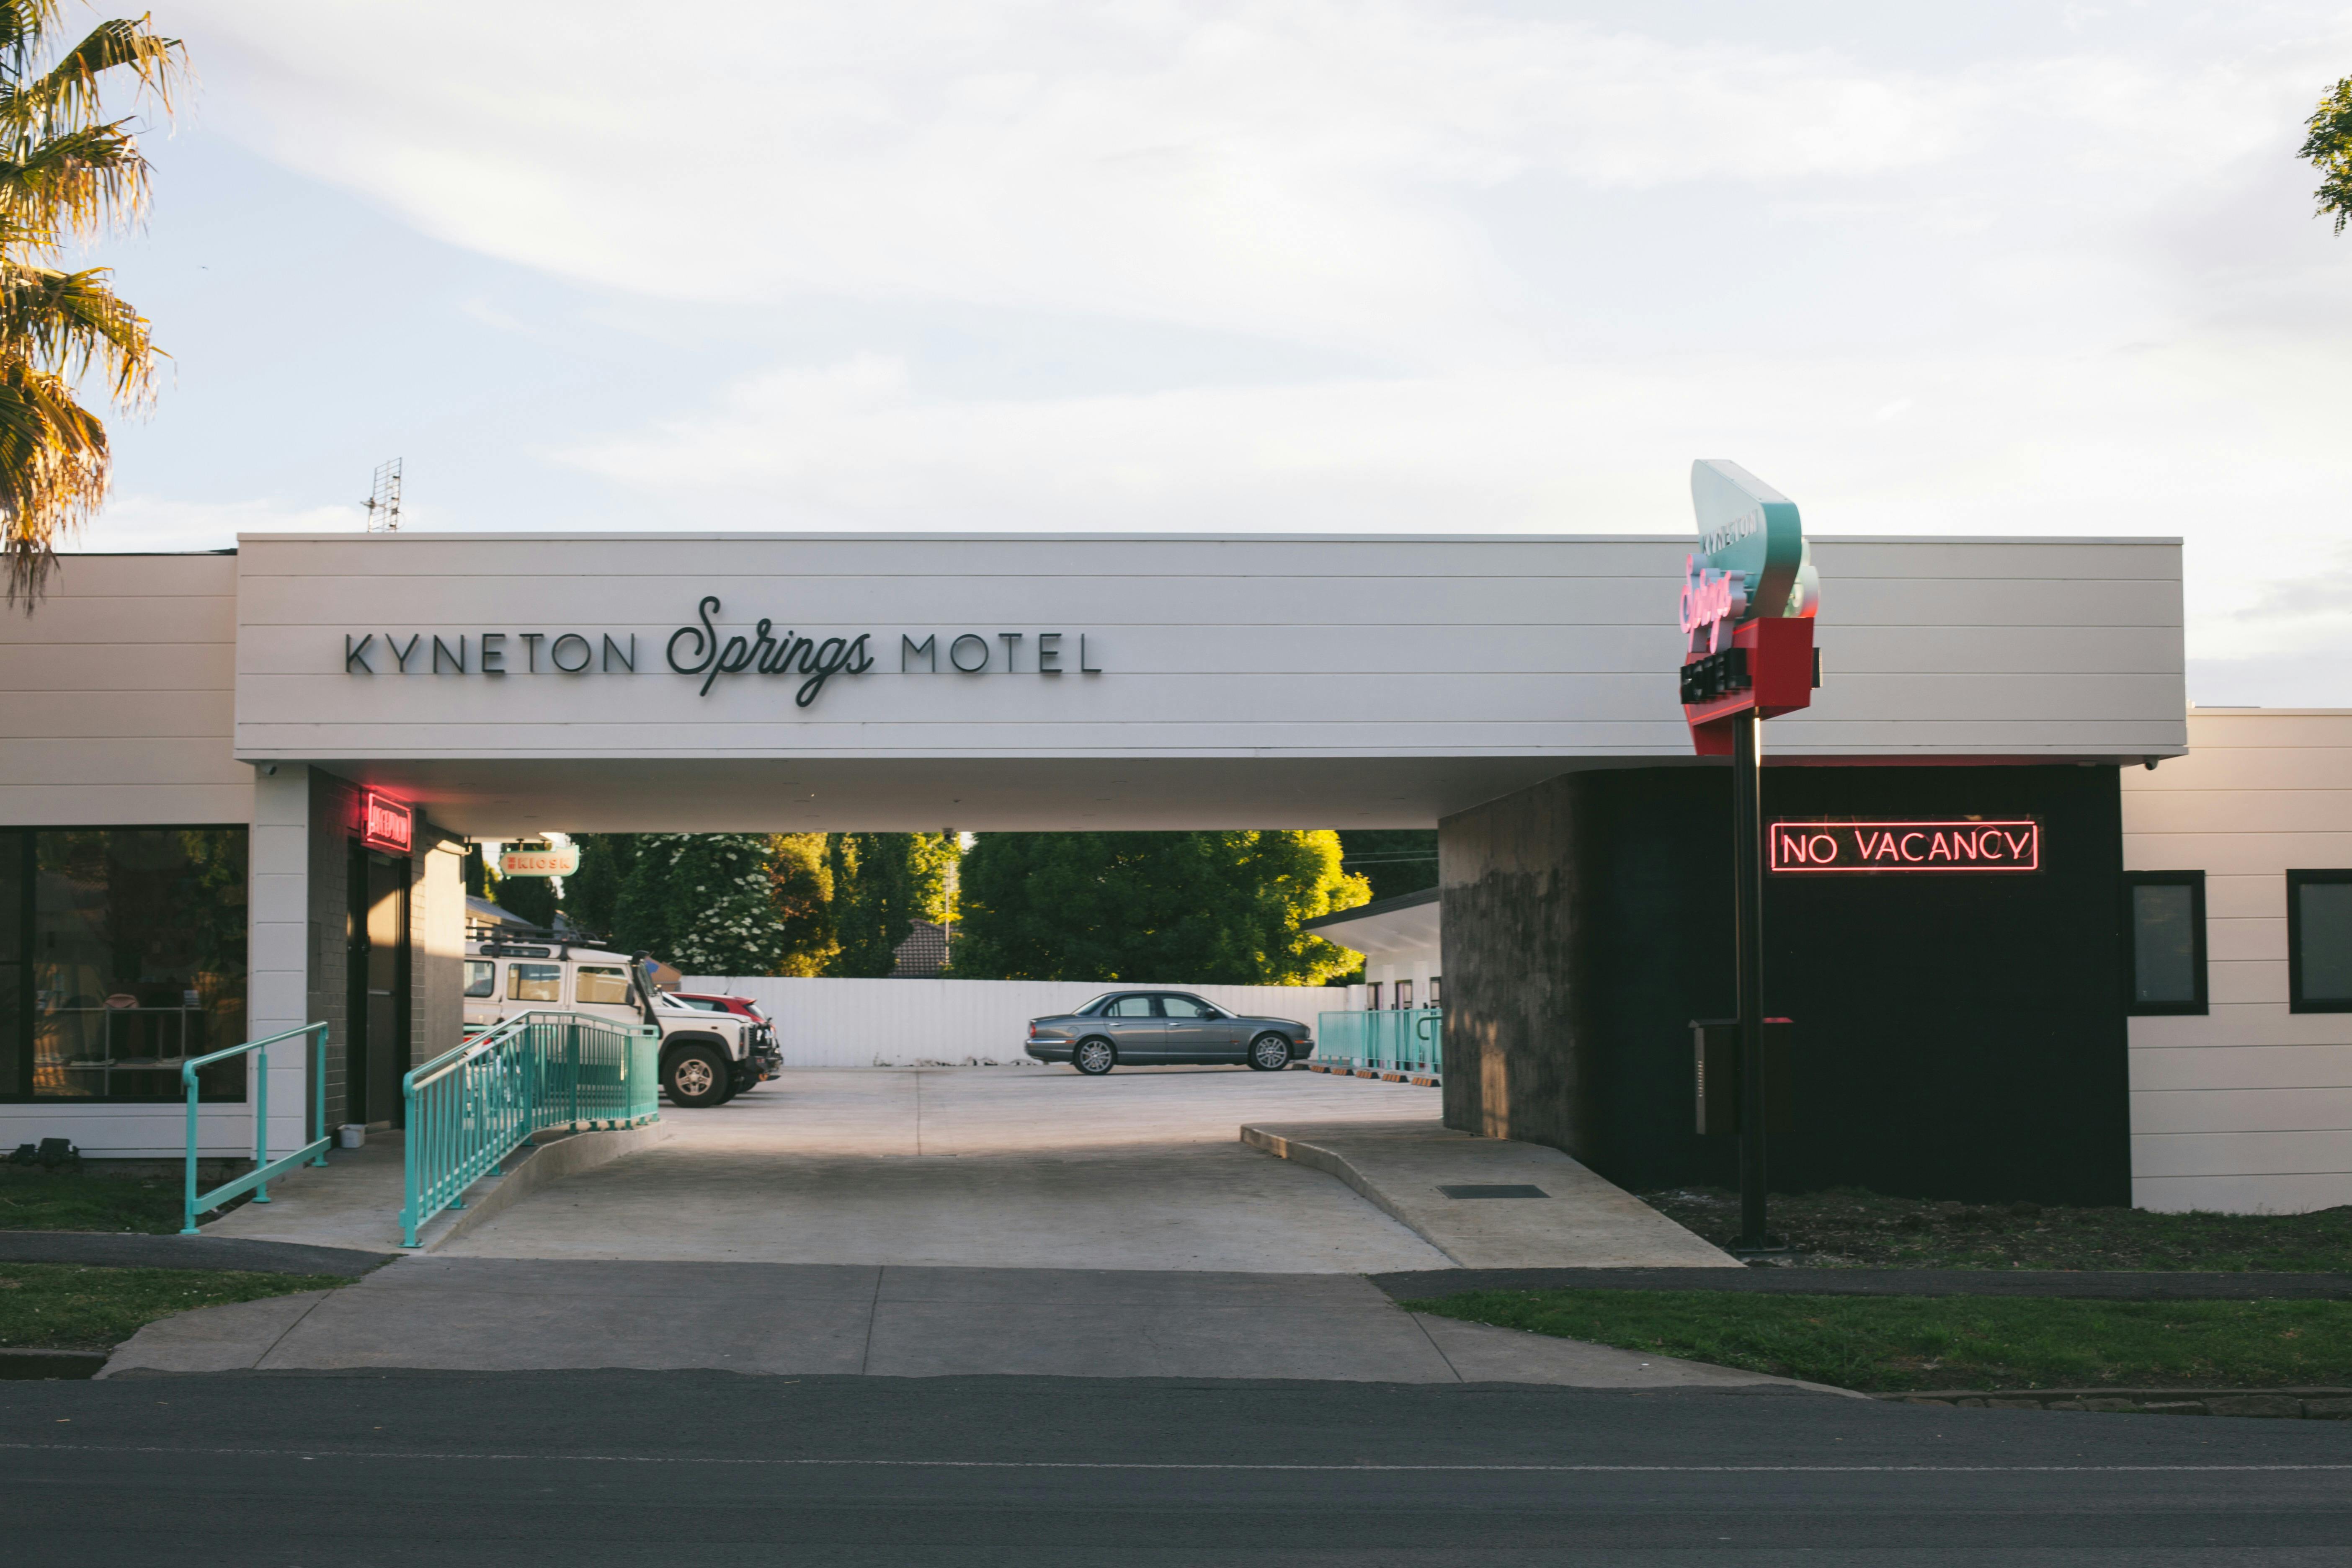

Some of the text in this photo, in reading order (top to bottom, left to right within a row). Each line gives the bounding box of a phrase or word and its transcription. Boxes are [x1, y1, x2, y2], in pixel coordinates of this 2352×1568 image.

[1702, 510, 1758, 557] KYNETON
[346, 596, 1102, 708] KYNETON Springs MOTEL
[517, 857, 570, 869] KIOSK
[1784, 830, 2030, 863] NO VACANCY
